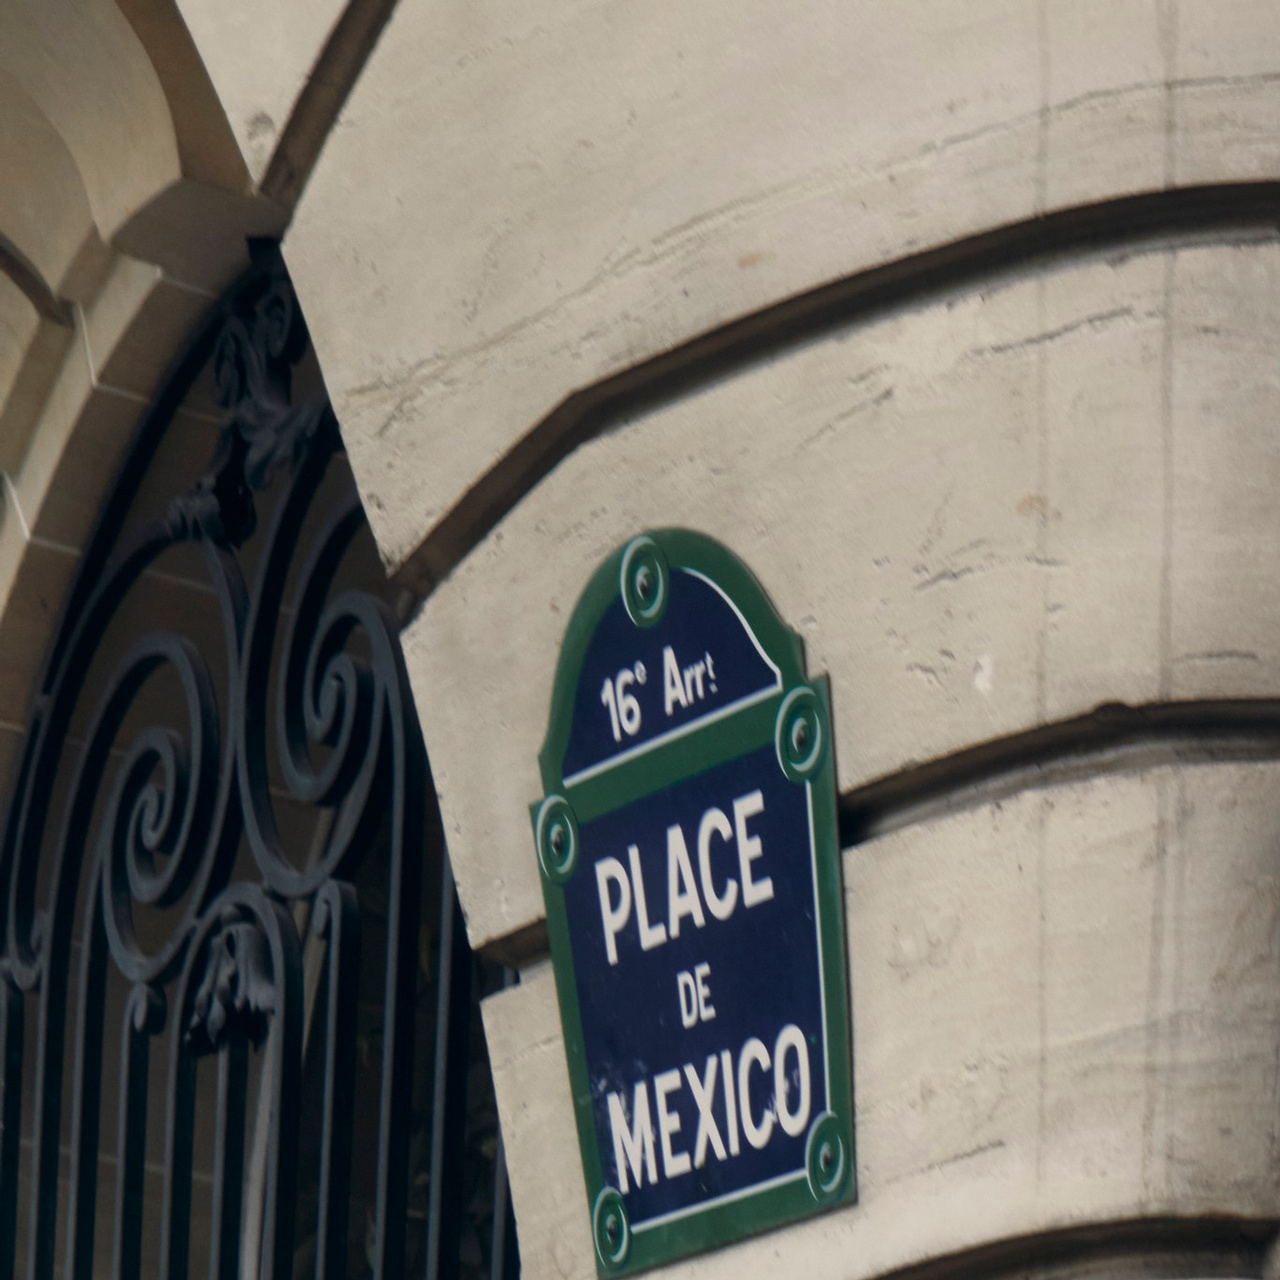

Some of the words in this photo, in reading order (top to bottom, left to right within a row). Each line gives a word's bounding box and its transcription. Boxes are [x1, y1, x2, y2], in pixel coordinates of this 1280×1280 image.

[595, 788, 775, 966] PLACE
[677, 961, 717, 1029] DE
[606, 1023, 811, 1195] MEXICO
